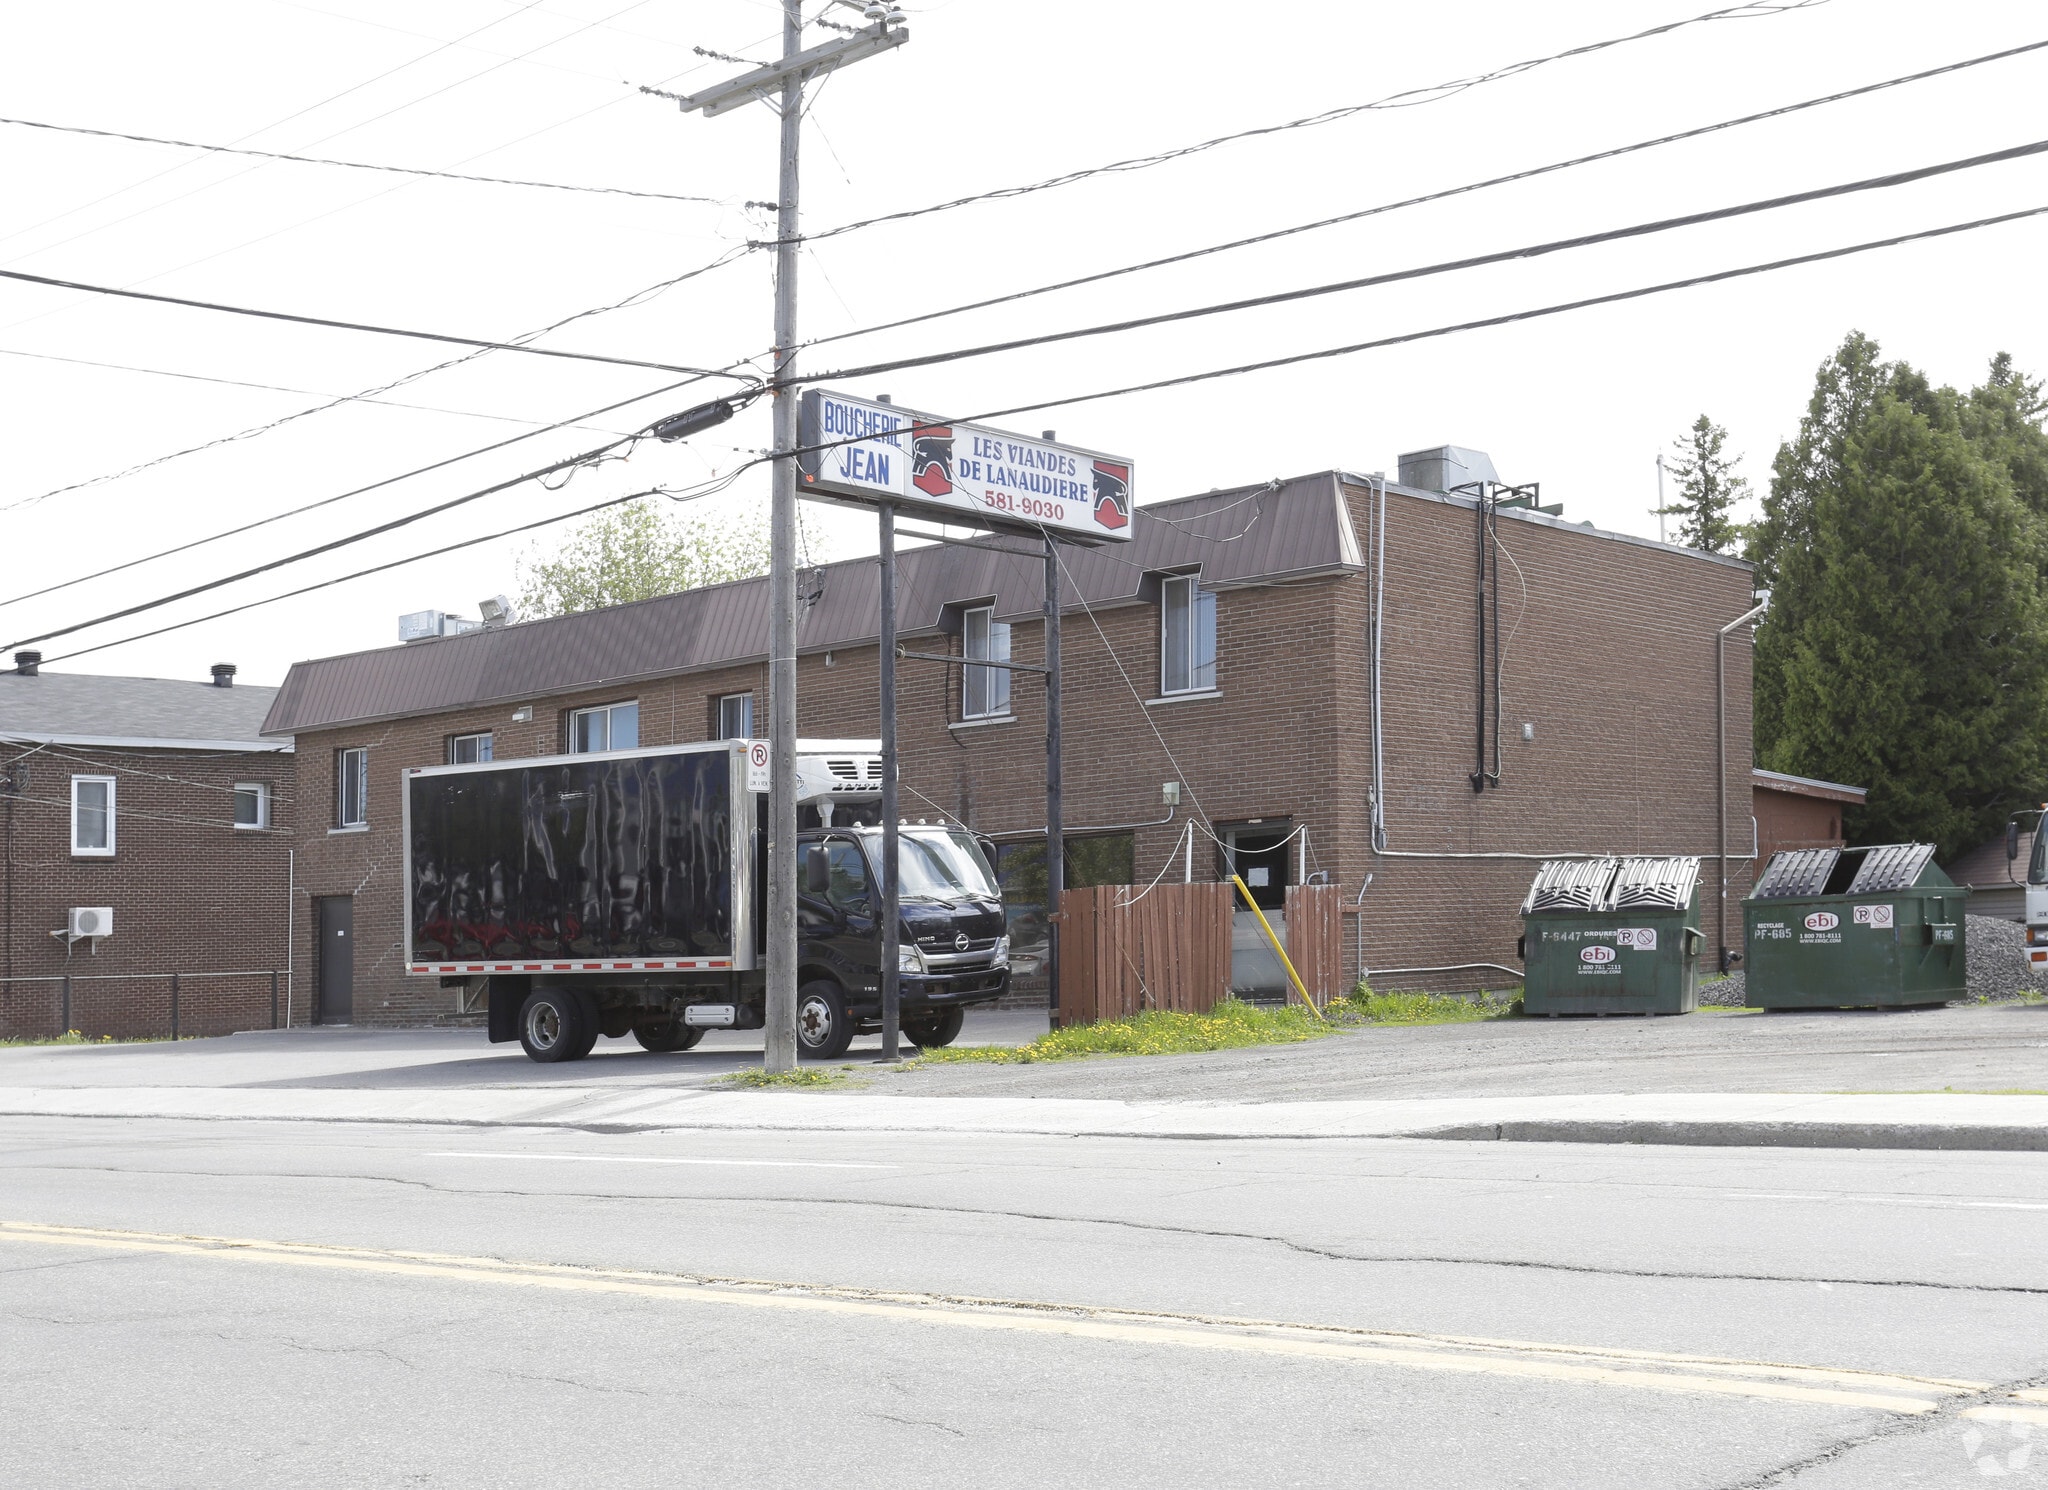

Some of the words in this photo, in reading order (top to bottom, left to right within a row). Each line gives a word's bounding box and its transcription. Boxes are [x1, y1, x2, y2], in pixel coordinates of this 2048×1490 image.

[824, 401, 902, 448] BOUCHERIE
[840, 446, 890, 486] JEAN
[973, 436, 1001, 461] LES
[1006, 444, 1076, 477] VIANDES
[959, 458, 981, 481] DE
[986, 464, 1088, 503] LANAUDIERE
[985, 490, 1064, 520] 581-9030
[1755, 929, 1792, 939] PF-685
[1807, 914, 1834, 927] ebi
[1583, 947, 1611, 960] ebi
